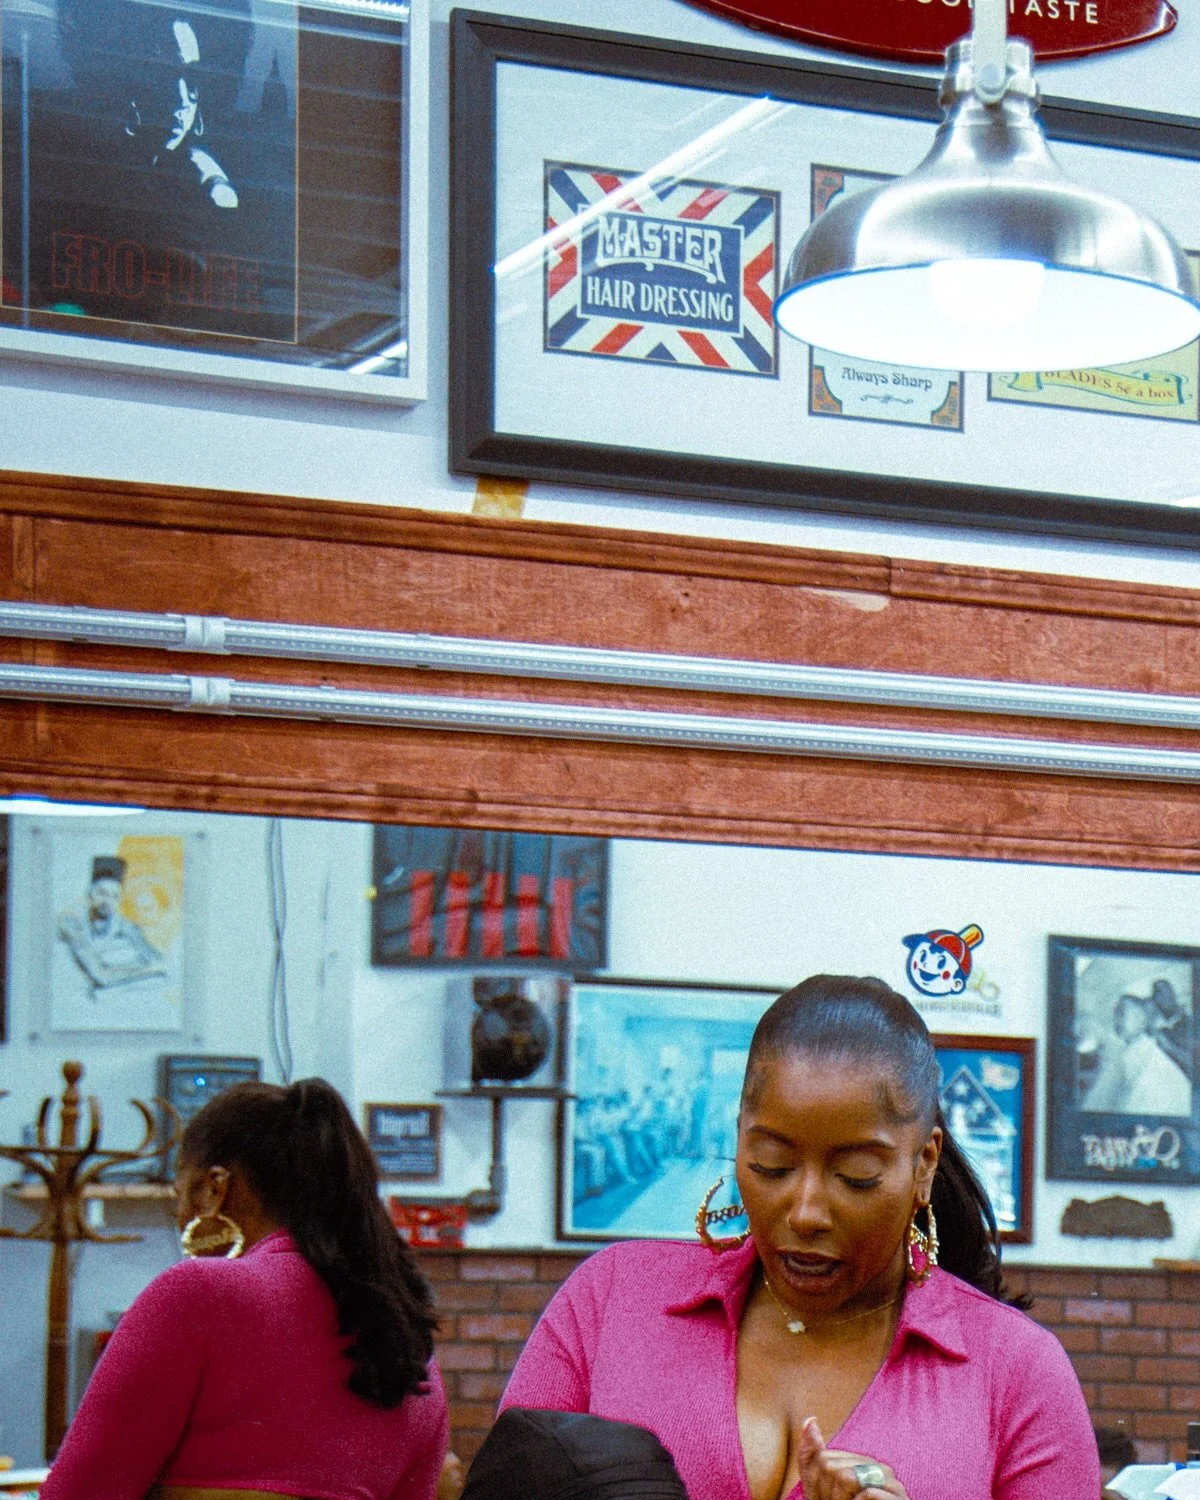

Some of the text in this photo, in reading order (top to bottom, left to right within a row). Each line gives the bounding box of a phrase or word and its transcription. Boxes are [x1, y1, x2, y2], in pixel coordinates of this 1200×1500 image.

[596, 214, 727, 284] MASTER
[586, 276, 734, 322] HAIR DRESSING
[842, 367, 933, 392] Always Sharp
[1149, 387, 1175, 399] box
